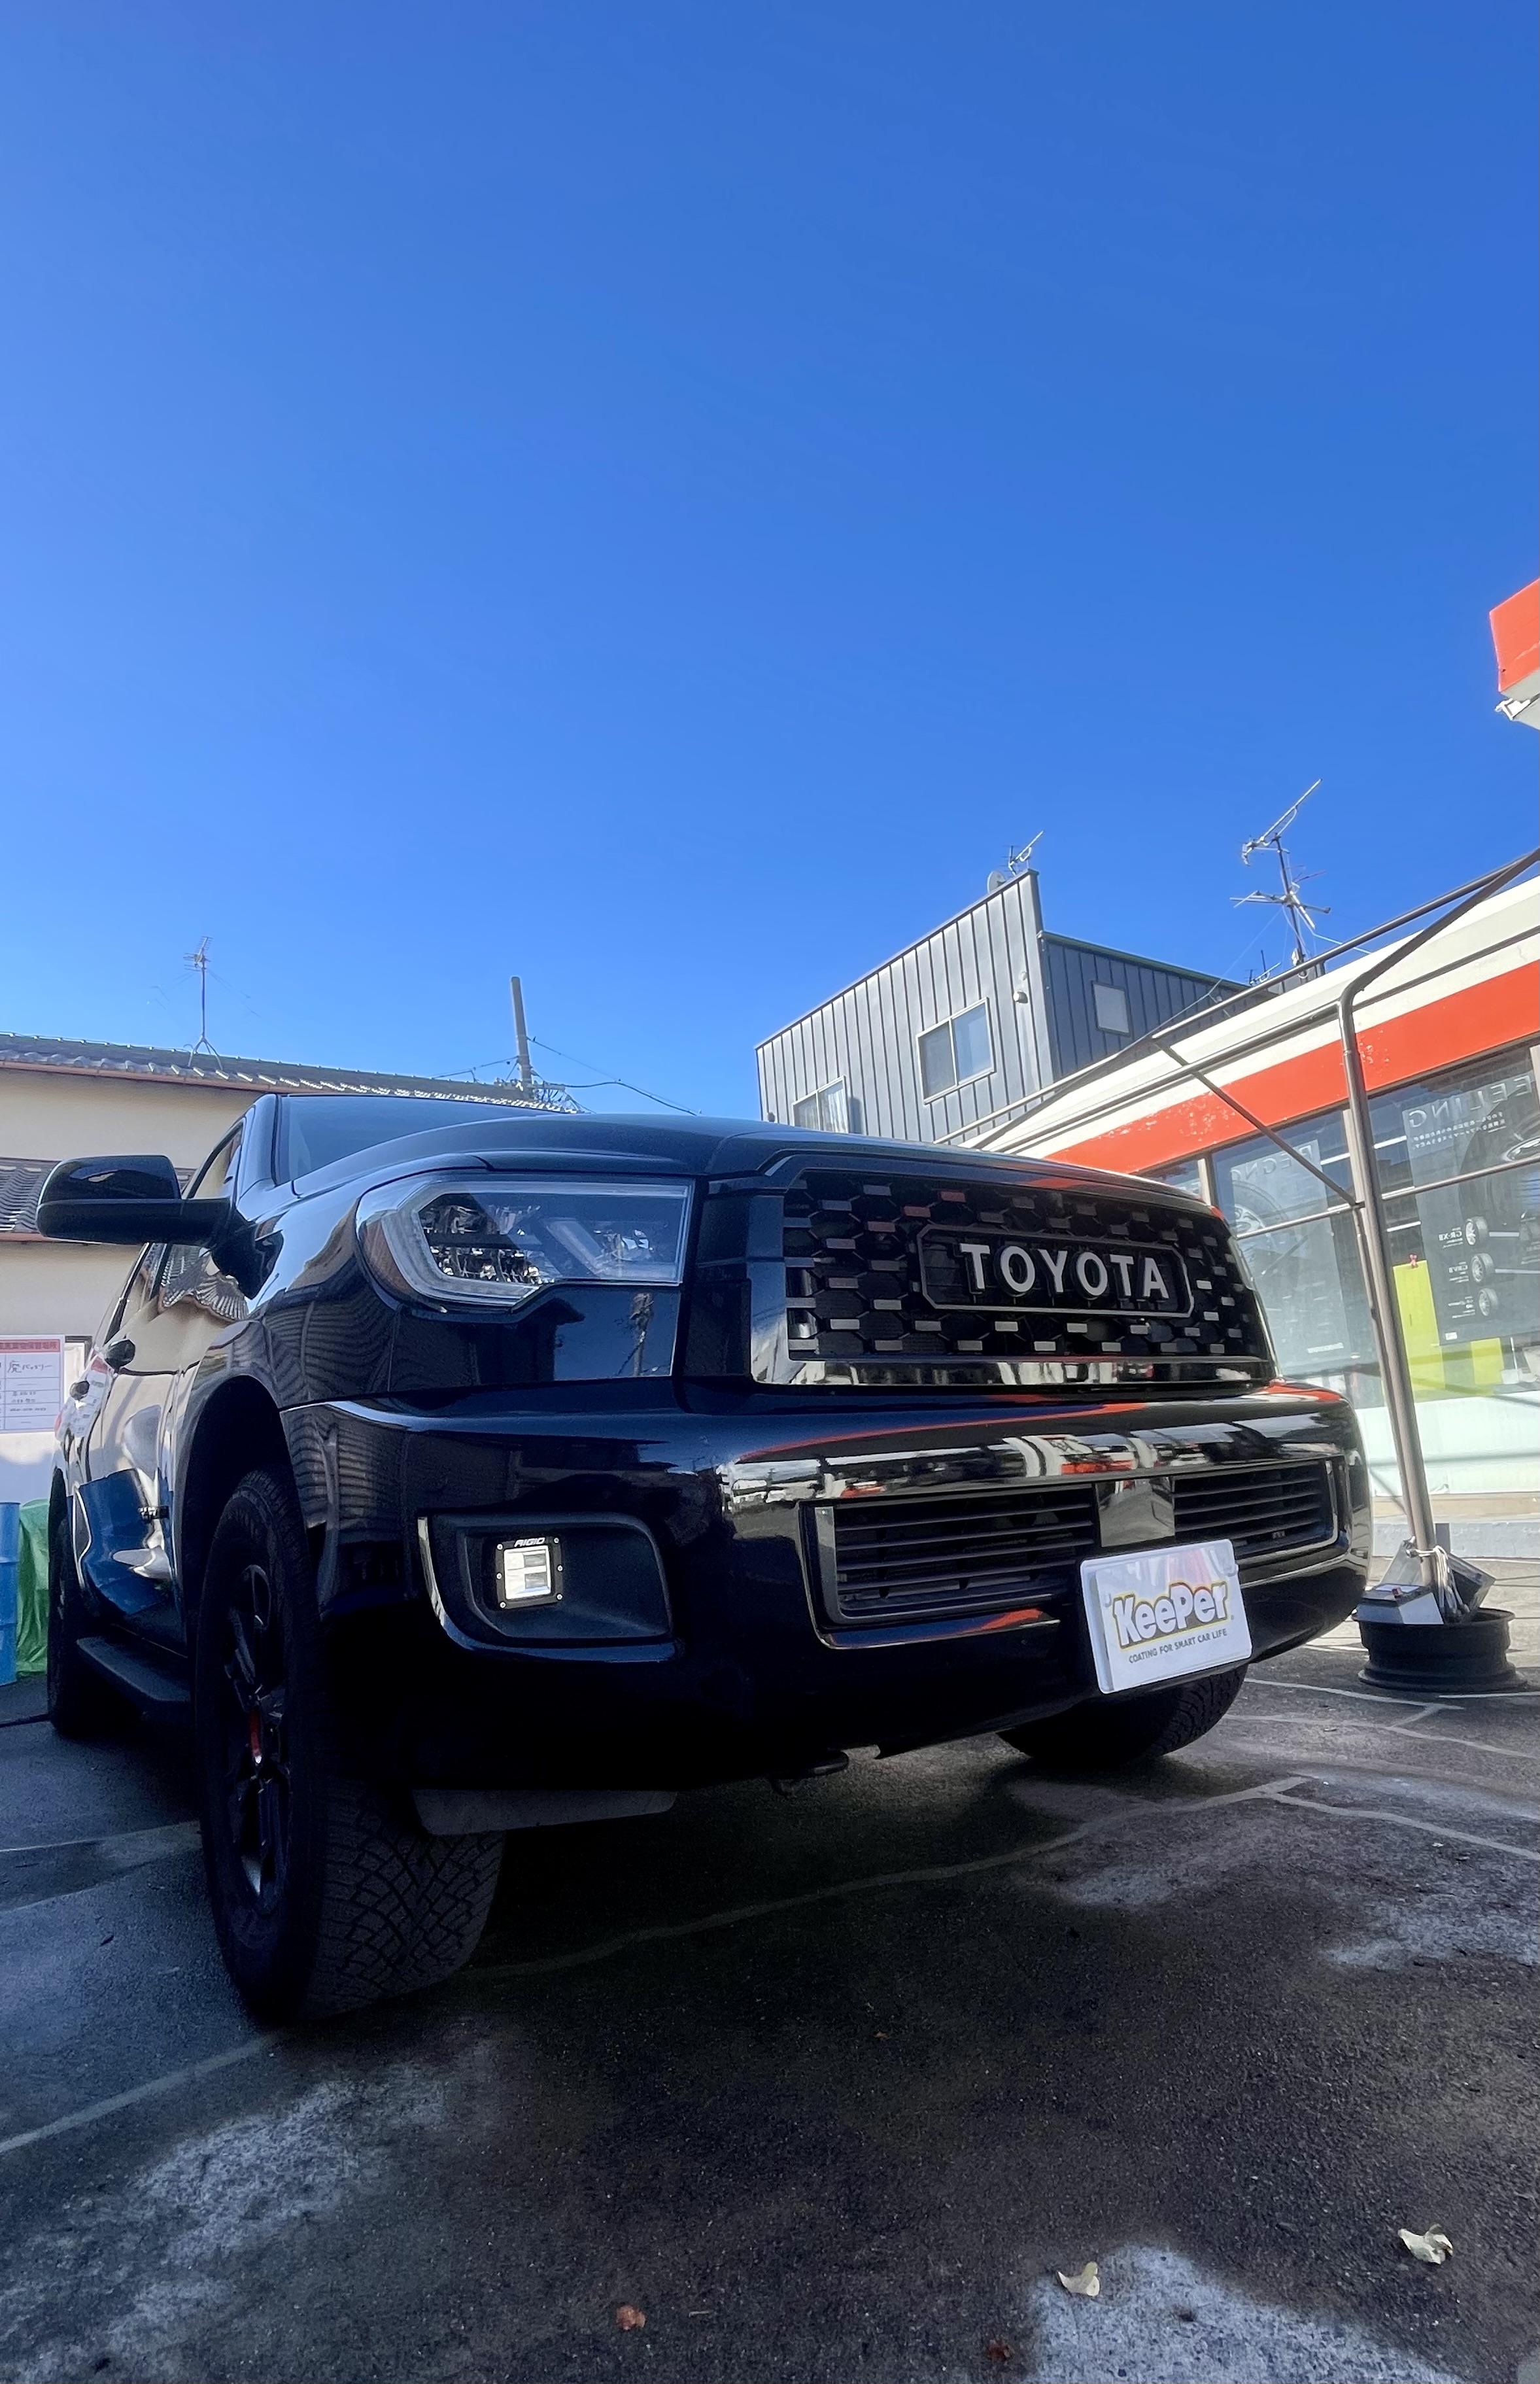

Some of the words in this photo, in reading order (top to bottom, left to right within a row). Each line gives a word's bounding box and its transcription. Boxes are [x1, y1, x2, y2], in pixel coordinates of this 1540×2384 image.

[959, 1243, 1169, 1300] TOYOTA
[1112, 1581, 1228, 1649] KeePer
[1129, 1648, 1157, 1663] COATING
[1160, 1644, 1173, 1655] FOR
[1174, 1636, 1196, 1650] SMART
[1198, 1633, 1211, 1643] CAR
[1212, 1629, 1227, 1639] LIFE
